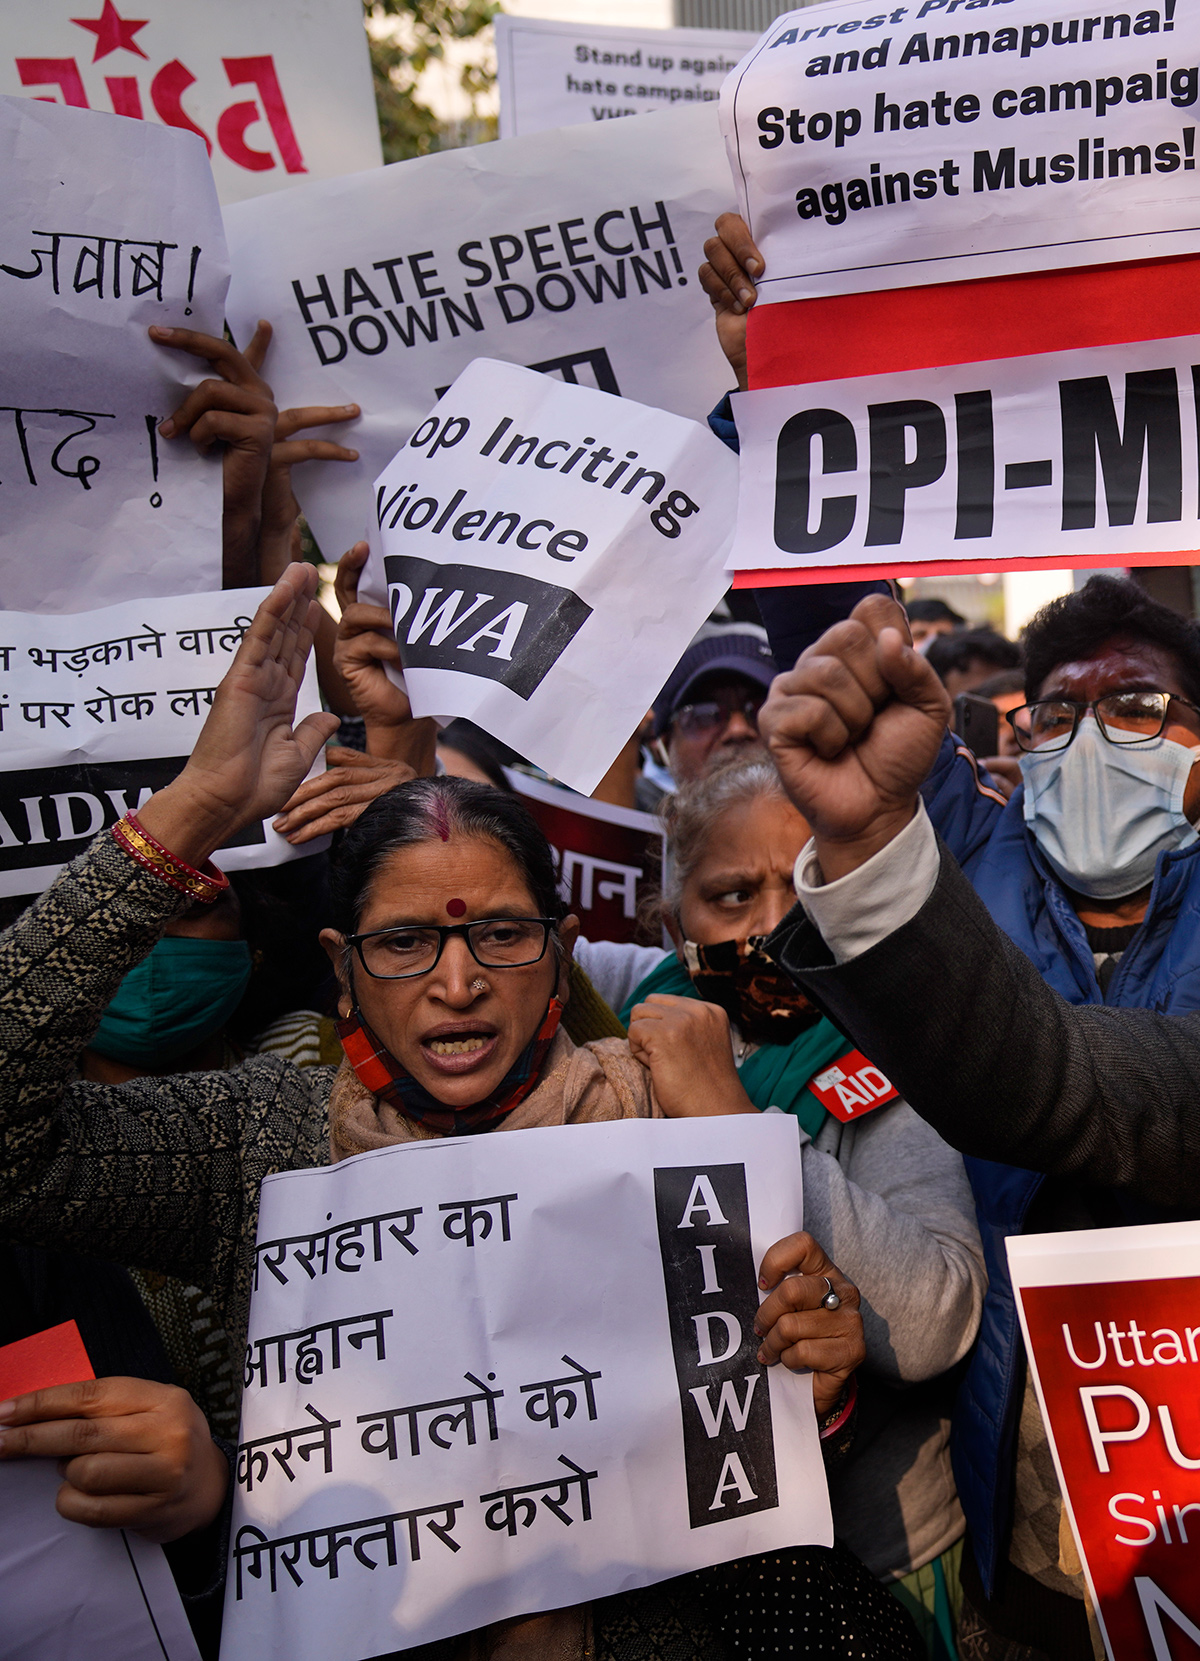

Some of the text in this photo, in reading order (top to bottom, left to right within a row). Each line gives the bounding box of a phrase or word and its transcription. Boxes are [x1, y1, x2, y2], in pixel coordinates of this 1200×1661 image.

[574, 45, 642, 67] Stand
[648, 55, 674, 72] up
[769, 8, 905, 50] Arrest
[805, 0, 1176, 77] and Annapurna!
[566, 74, 617, 95] hate
[757, 106, 861, 149] Stop
[874, 91, 981, 133] hate
[796, 127, 1196, 226] against Muslims!
[292, 201, 677, 324] HATE SPEECH
[307, 246, 687, 365] DOWN DOWN!
[409, 416, 699, 539] op Inciting
[377, 483, 589, 562] Violence
[28, 623, 166, 678] भड़काने
[20, 702, 75, 729] पर
[84, 686, 157, 723] रोक
[439, 1194, 519, 1248] का
[235, 1355, 601, 1493] करने वालों को
[233, 1454, 598, 1601] गिरफ्तार करो
